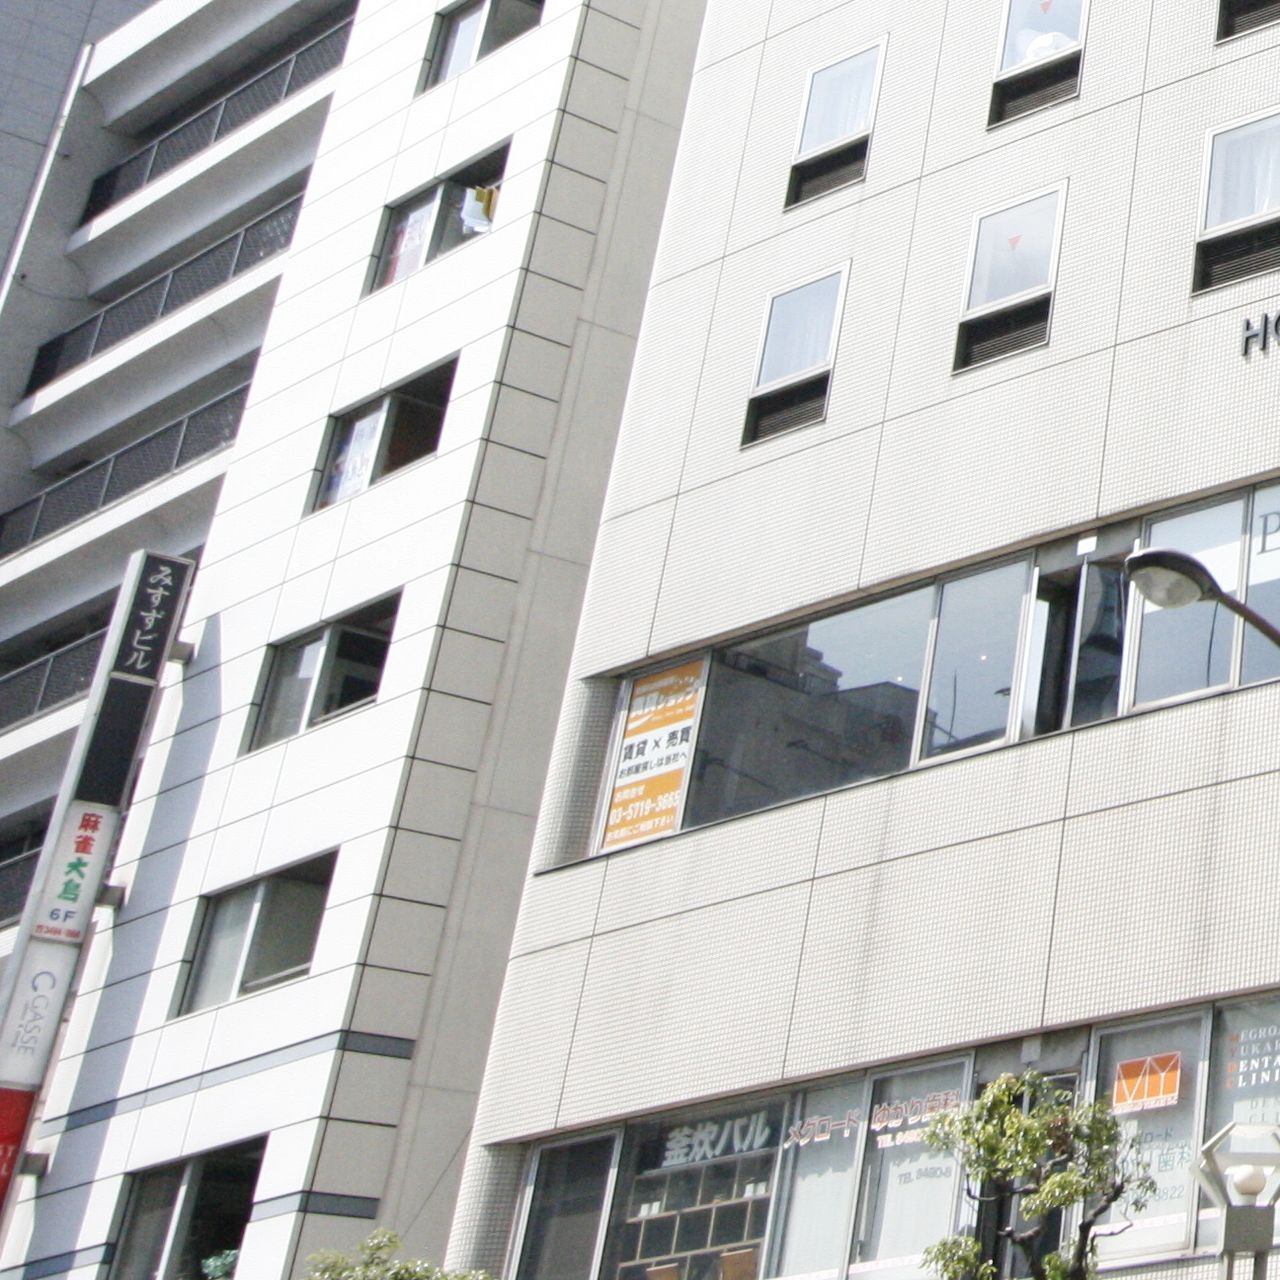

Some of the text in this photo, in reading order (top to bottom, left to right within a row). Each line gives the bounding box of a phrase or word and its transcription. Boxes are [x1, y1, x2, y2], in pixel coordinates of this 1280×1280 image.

[124, 564, 173, 670] みすずビル
